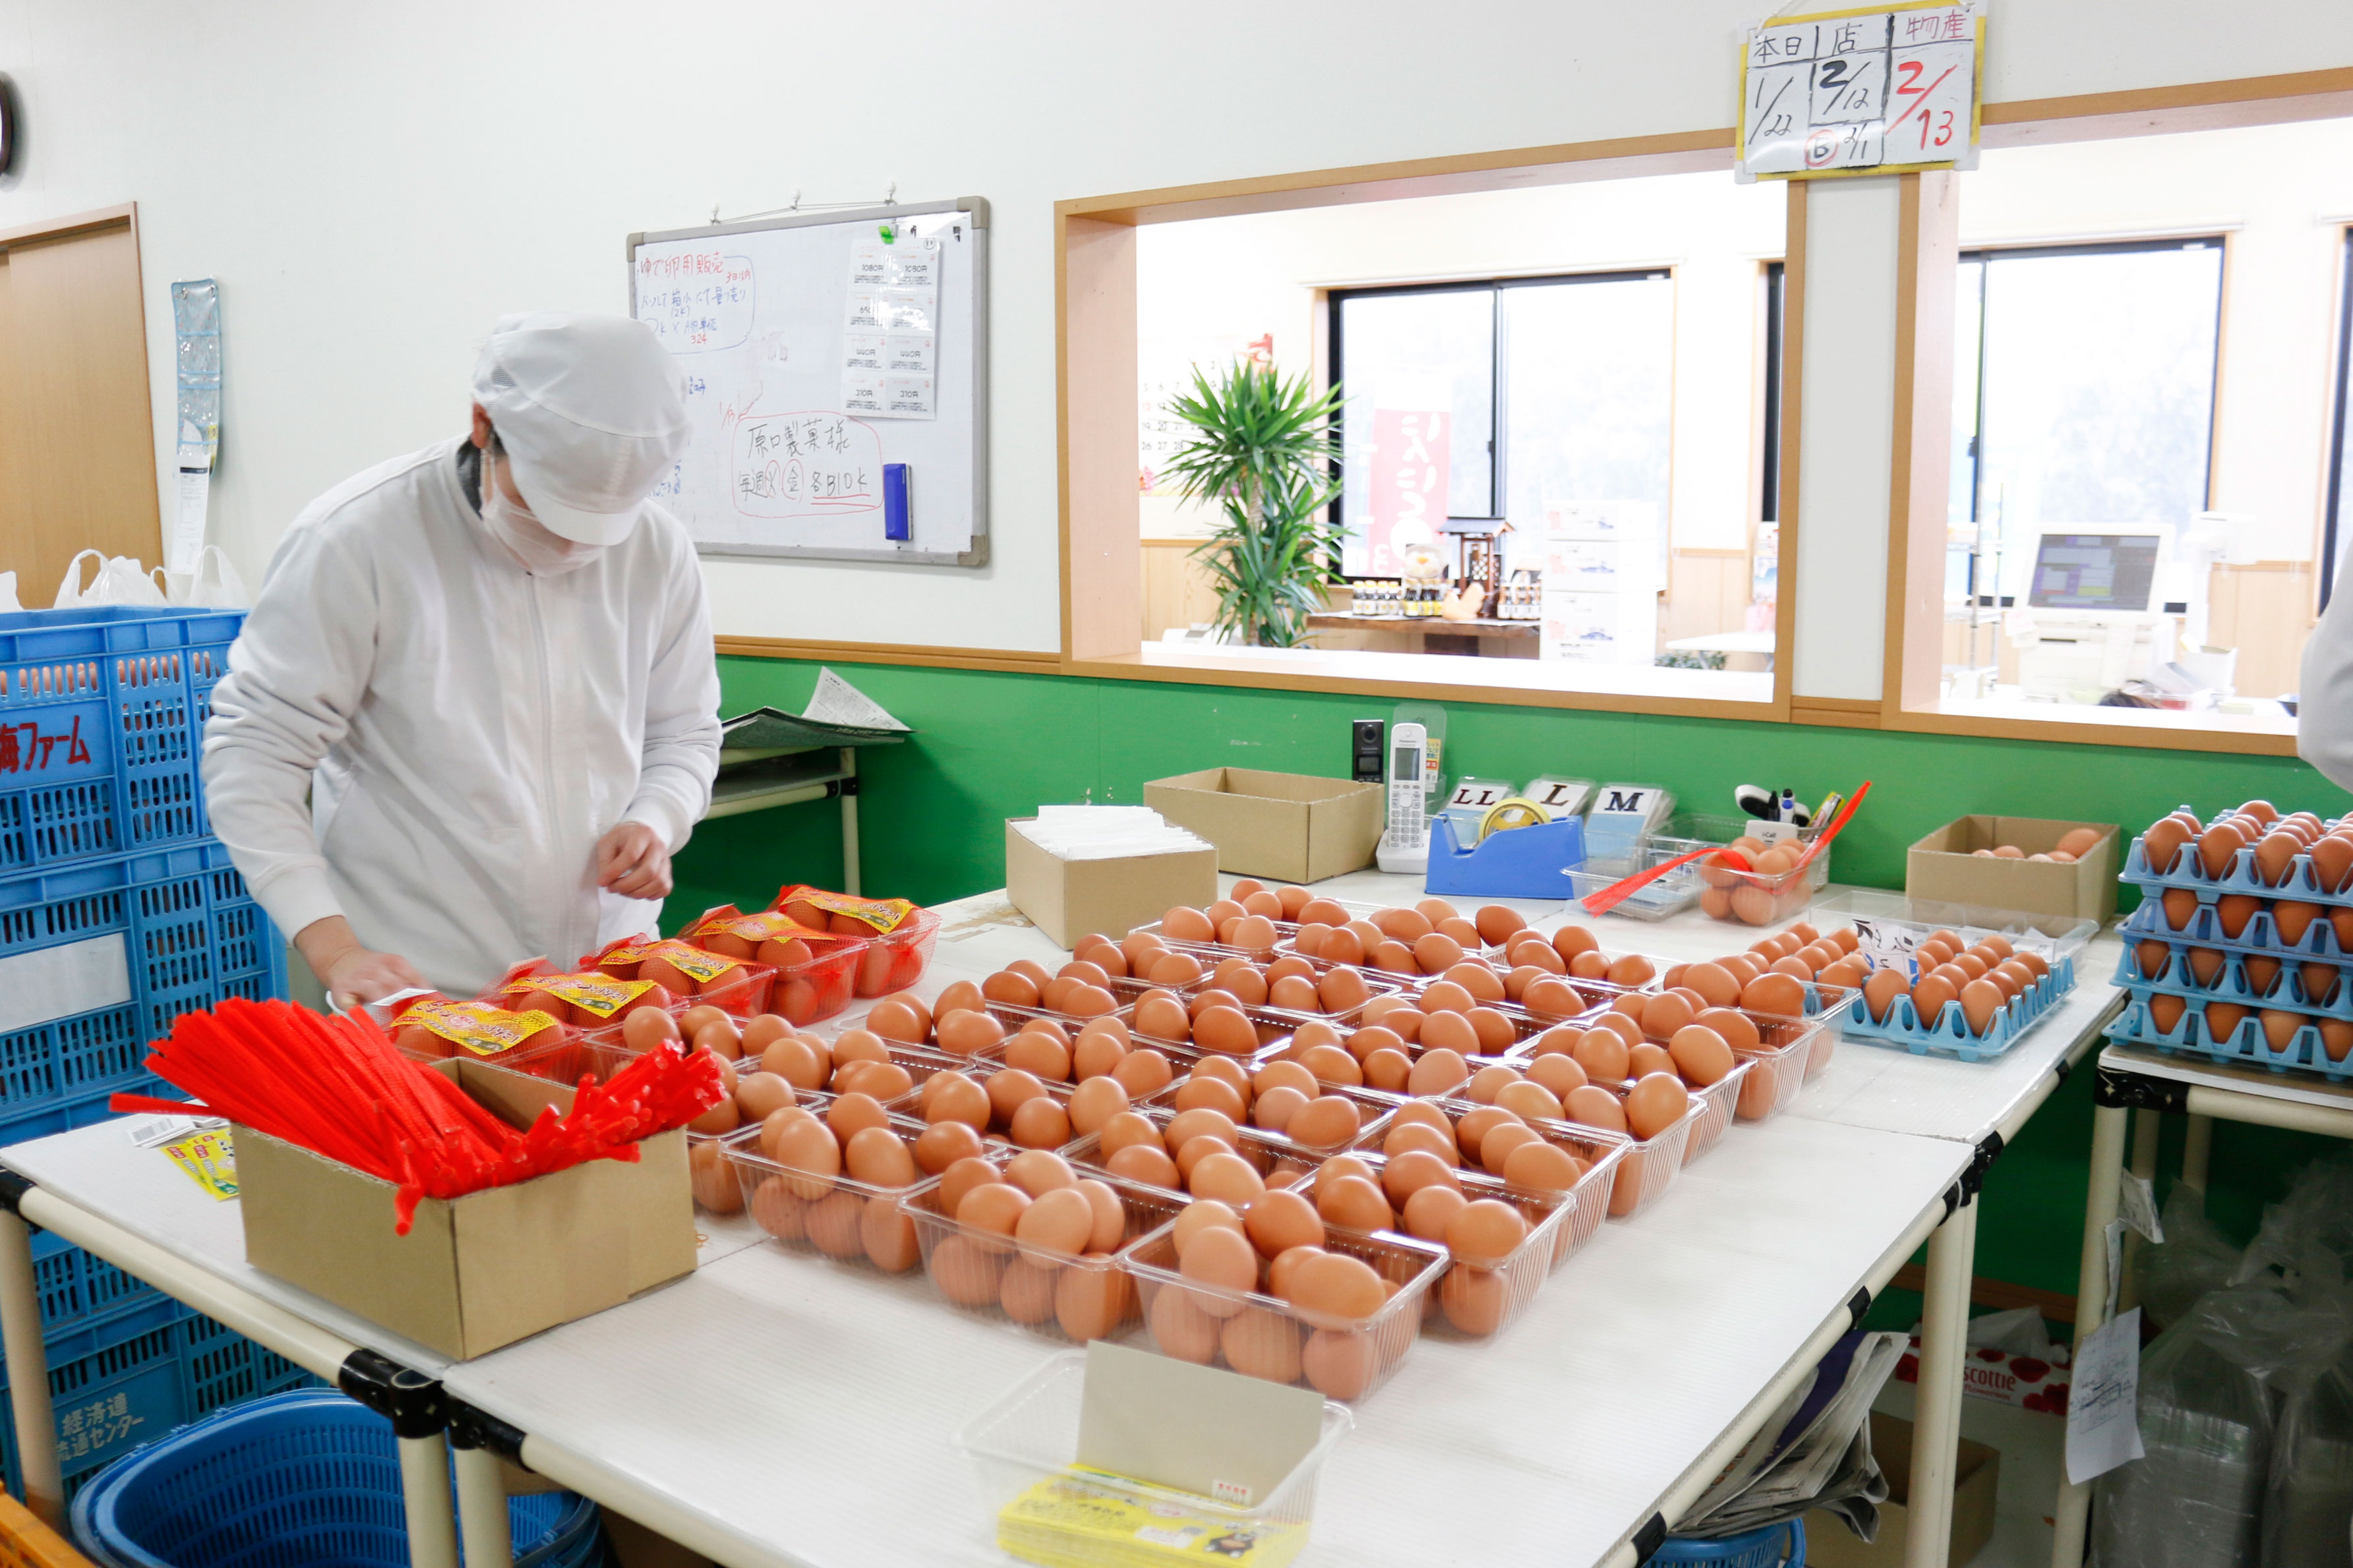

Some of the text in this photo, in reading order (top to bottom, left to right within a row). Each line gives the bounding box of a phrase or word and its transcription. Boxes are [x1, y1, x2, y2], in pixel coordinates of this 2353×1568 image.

[1754, 9, 1967, 63] 本日 店 物産
[1884, 61, 1958, 150] 2/13
[1453, 789, 1496, 805] LL
[1540, 784, 1569, 807] L
[1604, 791, 1644, 812] M
